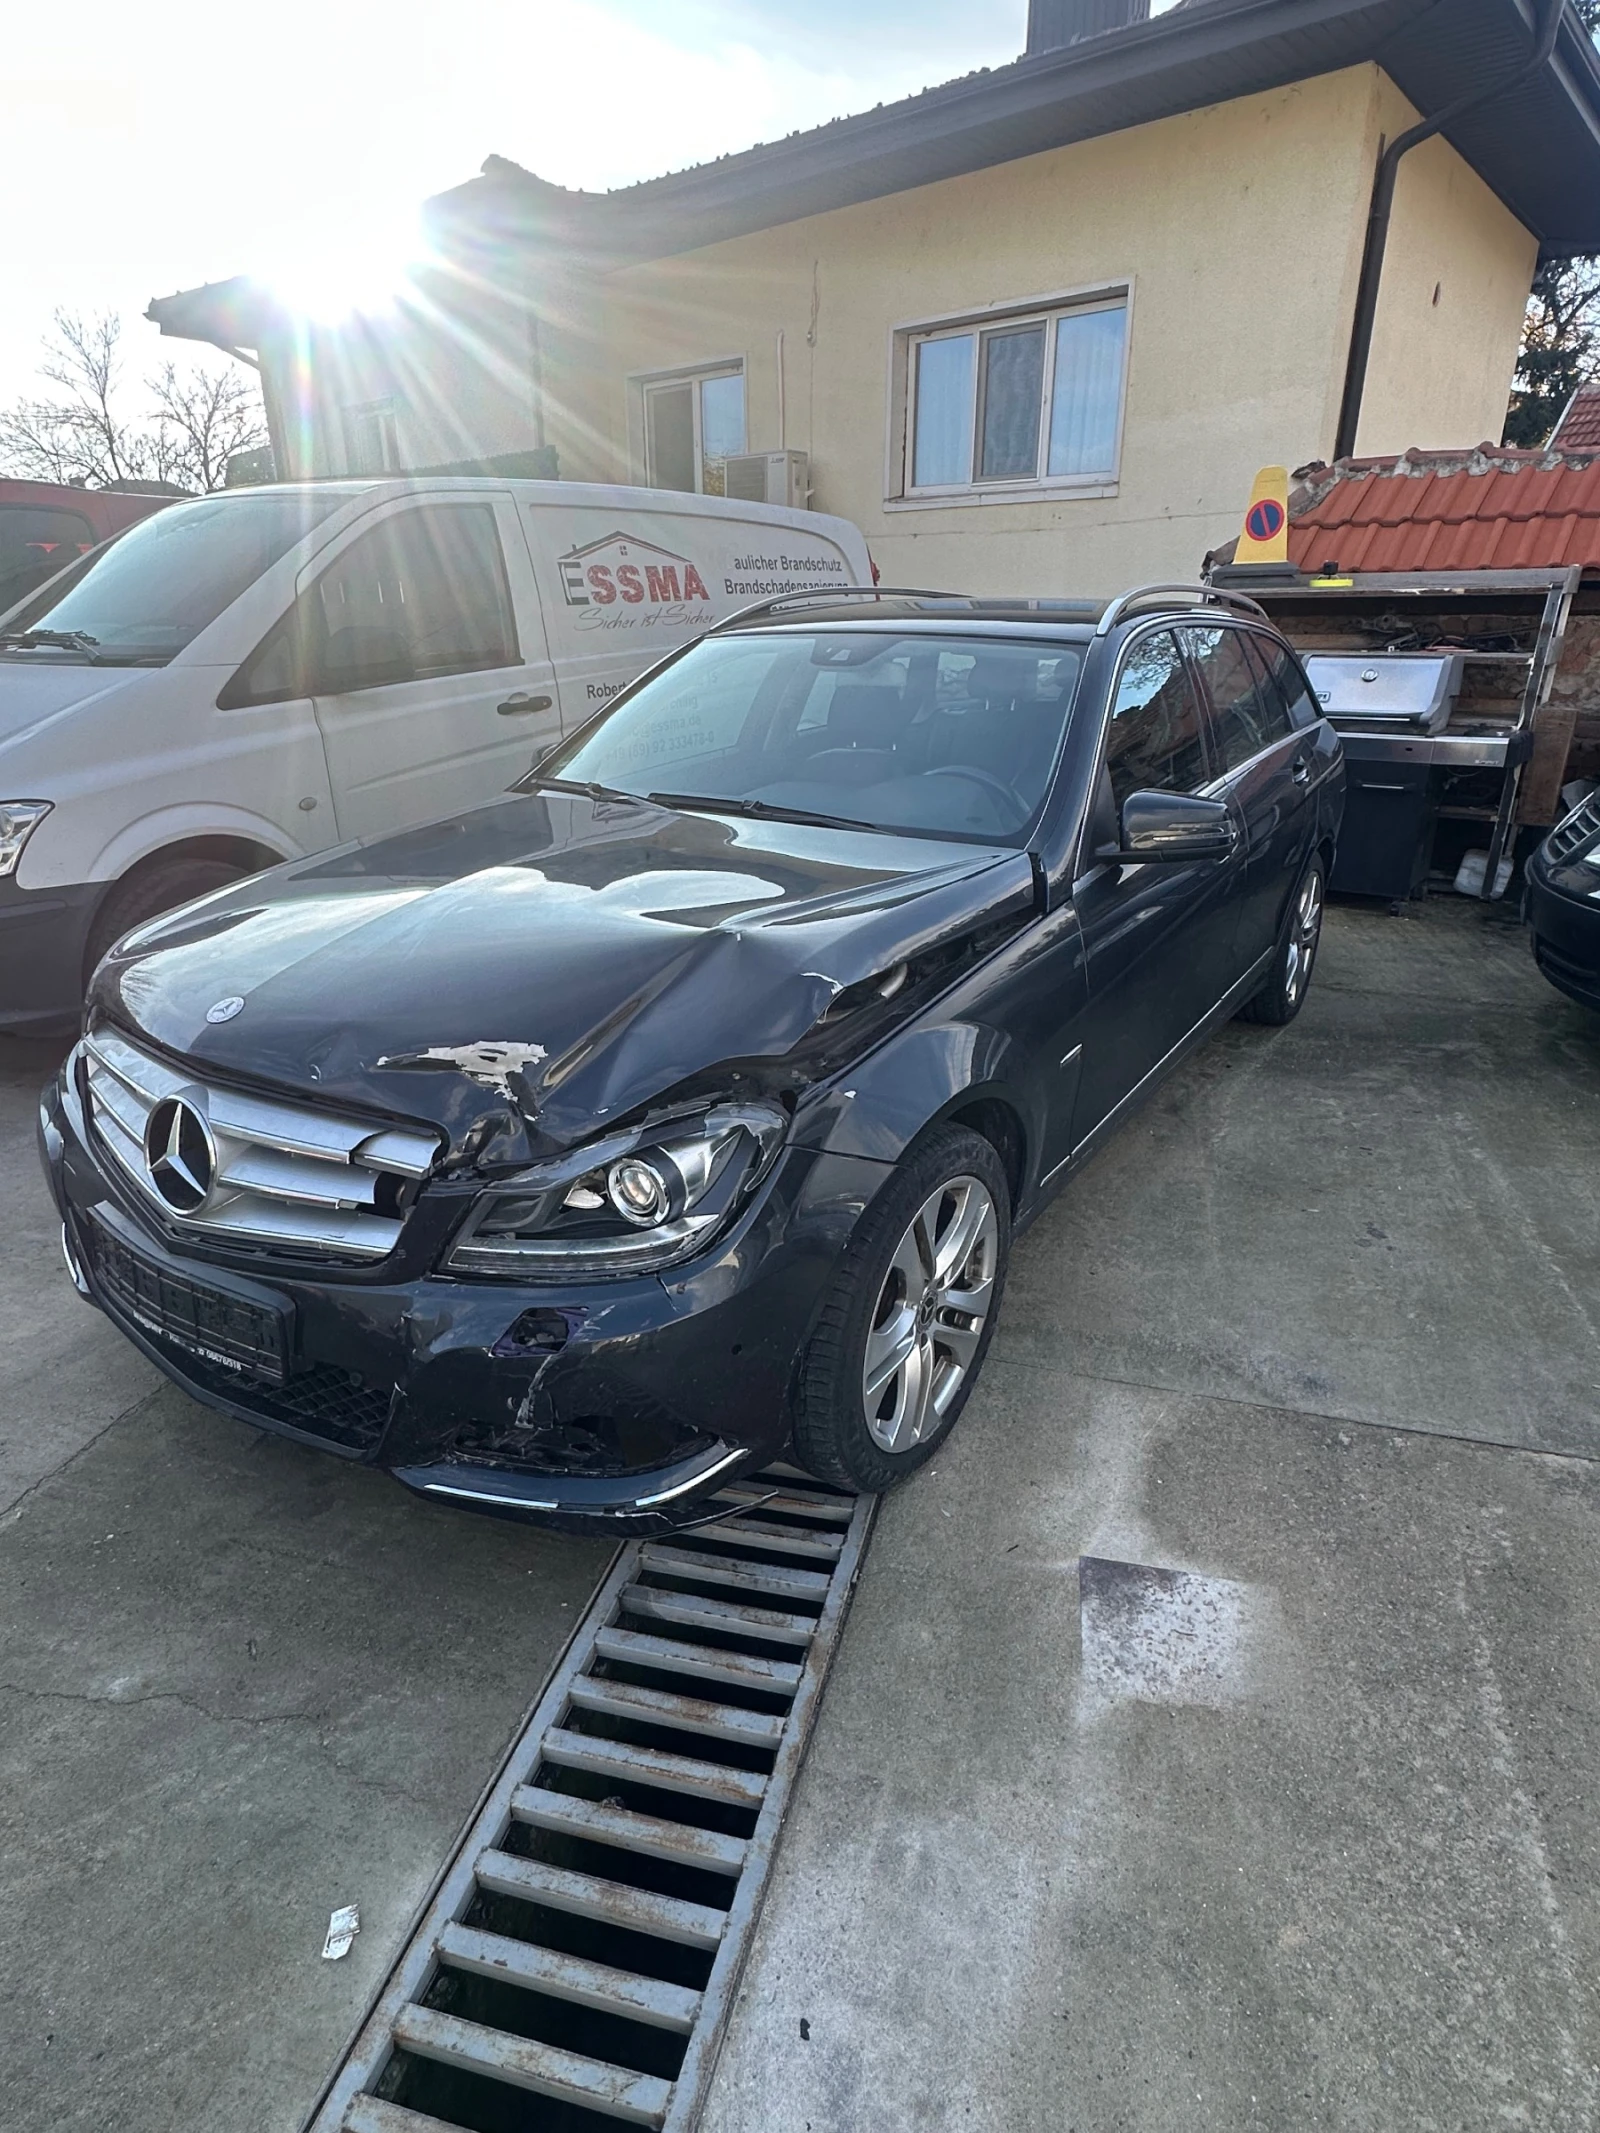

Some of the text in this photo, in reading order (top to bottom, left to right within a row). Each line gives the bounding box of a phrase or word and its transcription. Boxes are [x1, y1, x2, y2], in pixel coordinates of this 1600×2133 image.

[779, 554, 843, 573] Brandschutz
[557, 561, 711, 606] ESSMA
[573, 603, 716, 632] Sicher ist Sicher
[586, 681, 628, 699] Robert
